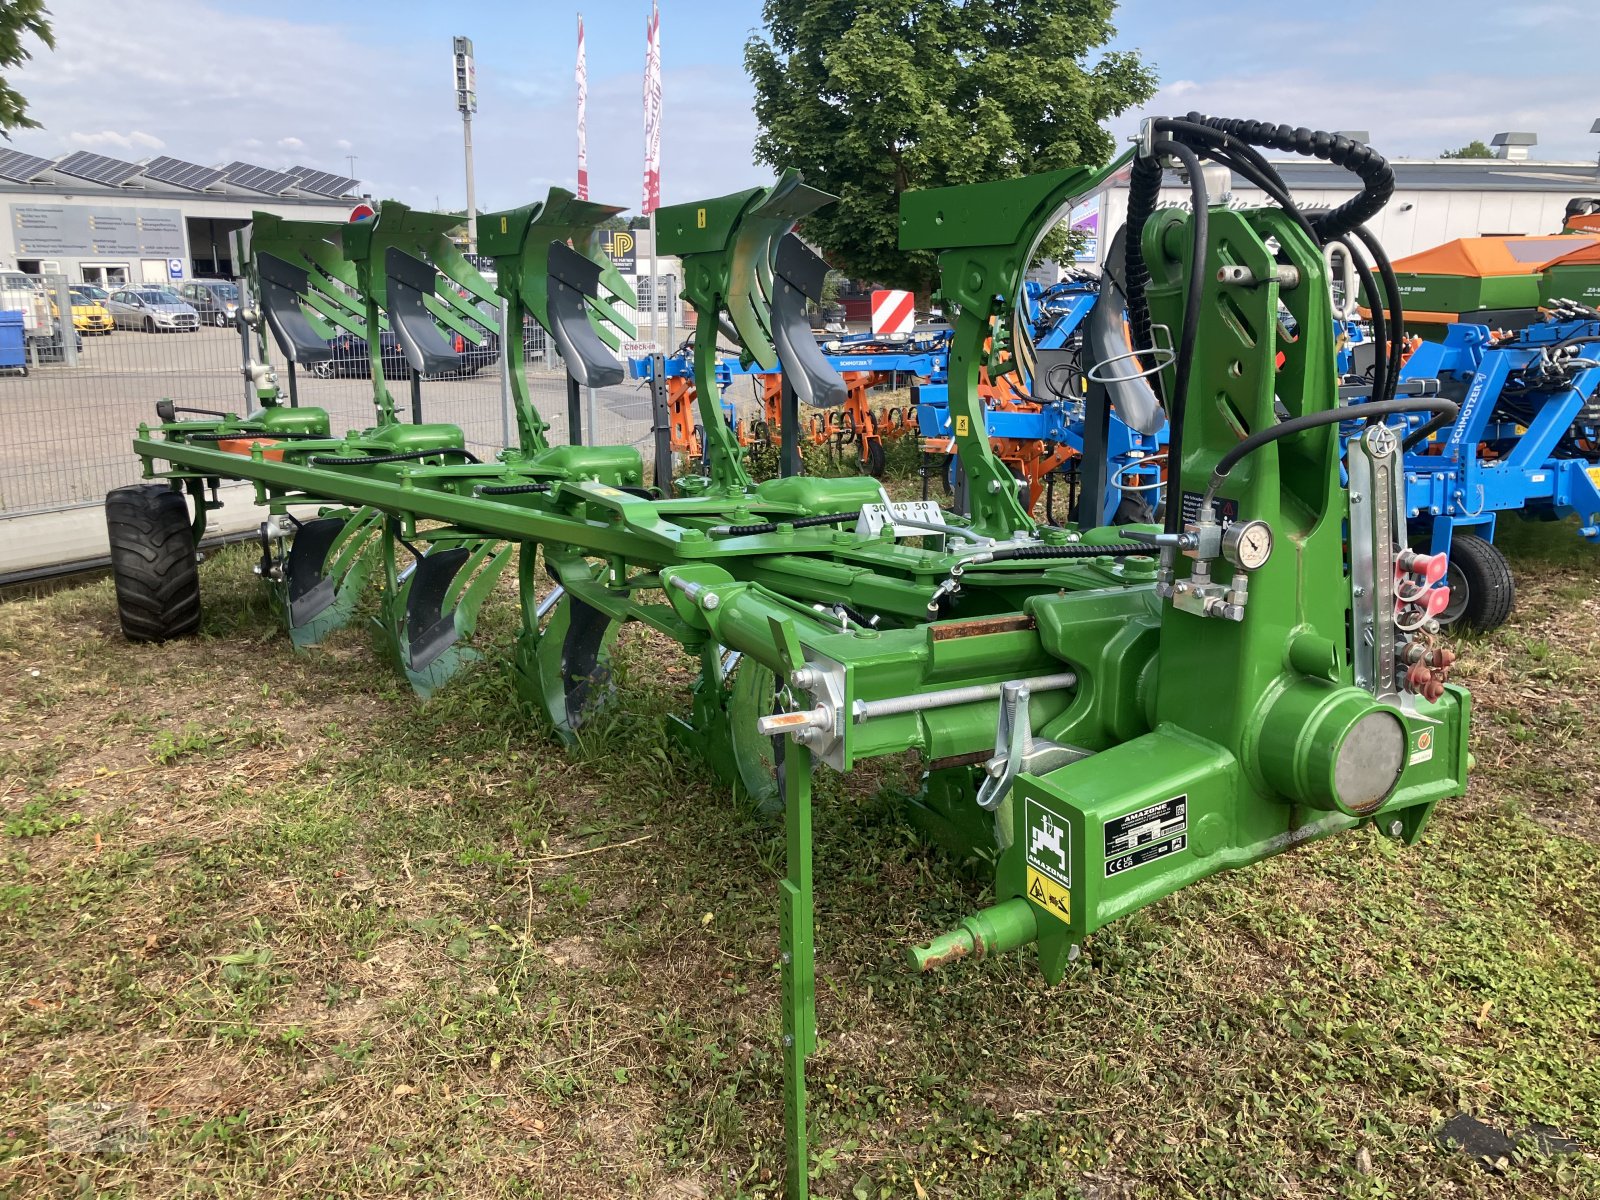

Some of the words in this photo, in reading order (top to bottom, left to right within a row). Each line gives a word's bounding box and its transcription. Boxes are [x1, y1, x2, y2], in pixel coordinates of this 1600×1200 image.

[624, 343, 655, 351] Check-in
[1451, 384, 1483, 444] SCHMOTZER
[872, 504, 886, 512] 30
[893, 503, 907, 511] 40
[915, 502, 929, 511] 50
[1124, 803, 1168, 823] AMAZONE
[1029, 854, 1069, 884] AMAZONE
